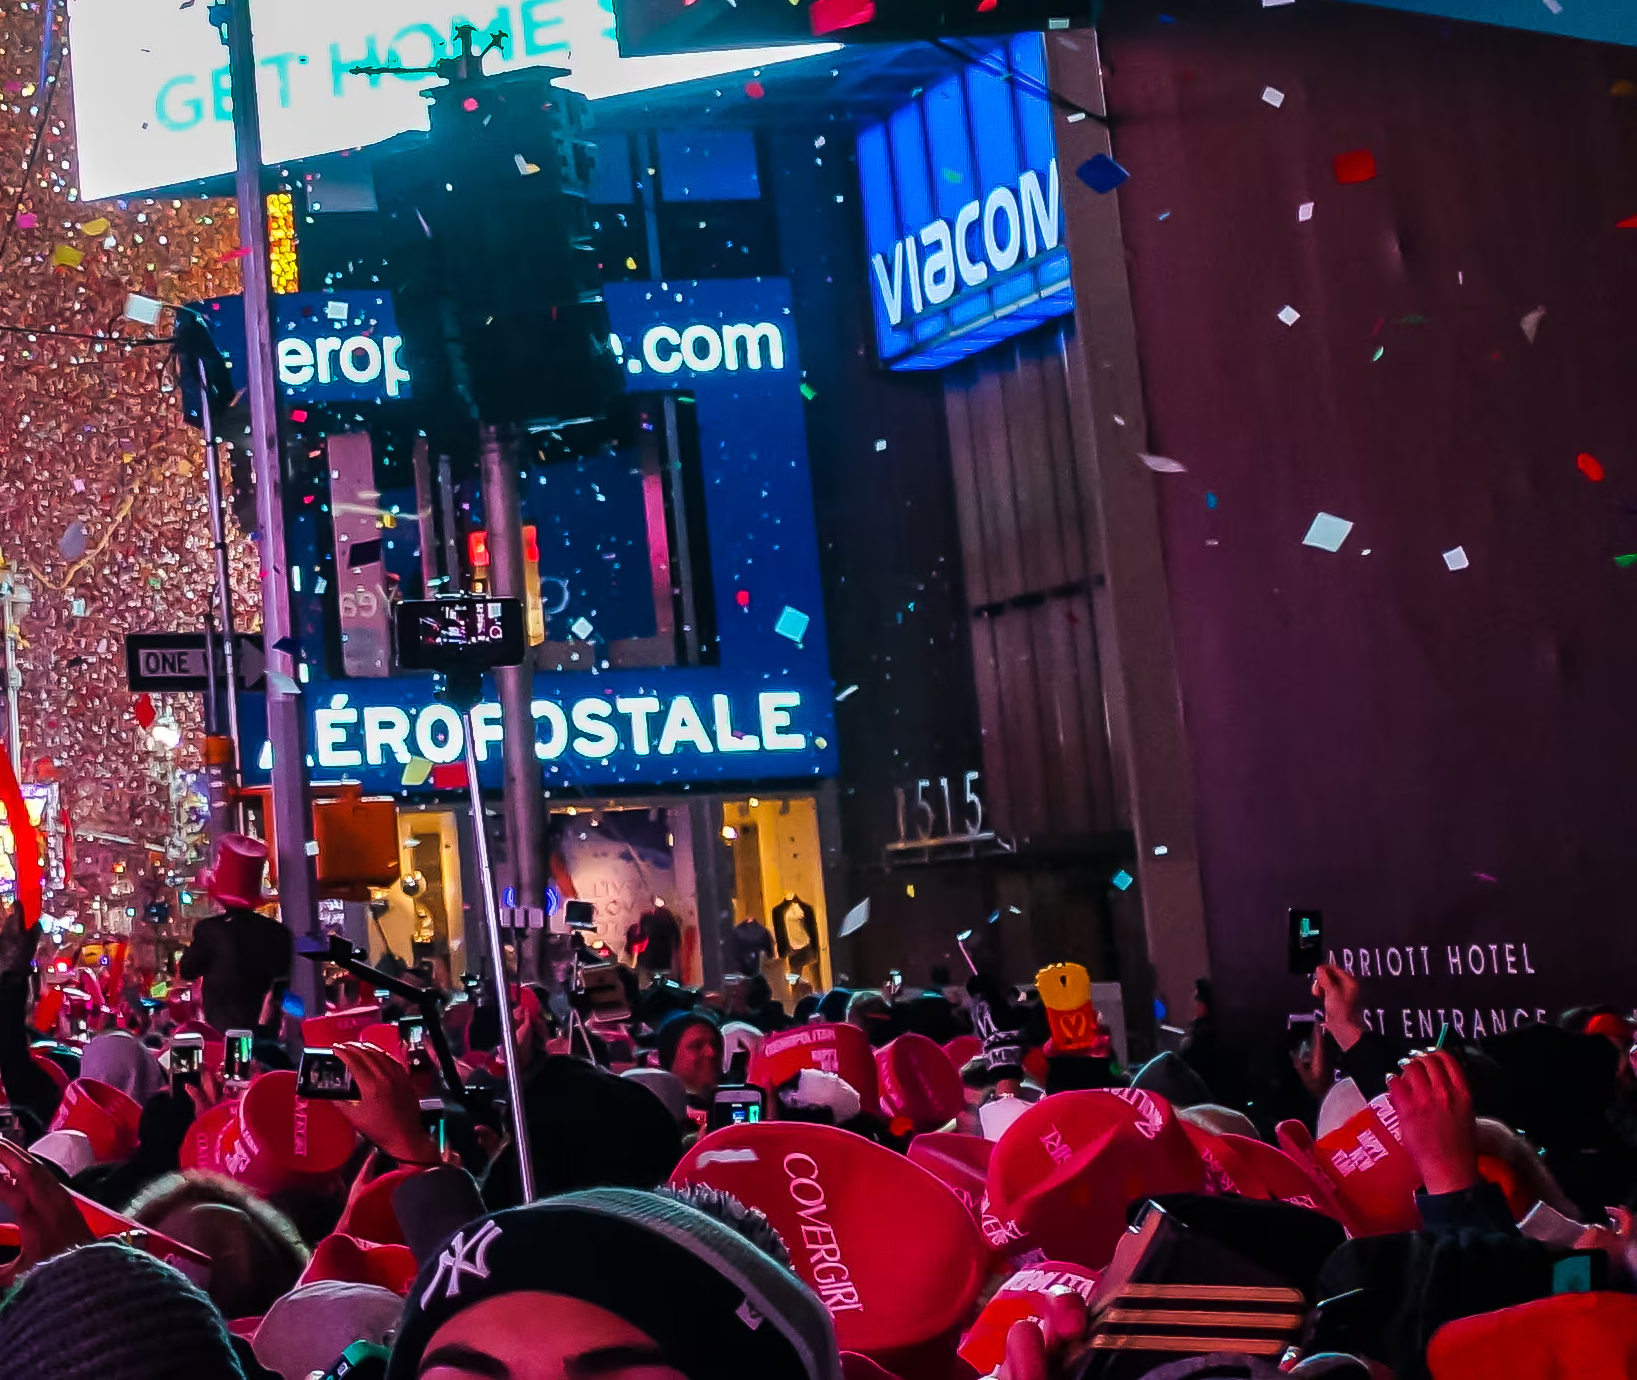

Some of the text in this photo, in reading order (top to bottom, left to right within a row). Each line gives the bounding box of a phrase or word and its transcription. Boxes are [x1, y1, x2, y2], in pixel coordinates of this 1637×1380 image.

[145, 652, 189, 673] ONE
[894, 771, 982, 841] 1515
[1327, 943, 1535, 977] ARRIOTT HOTEL
[783, 1151, 864, 1319] COVERGIRL
